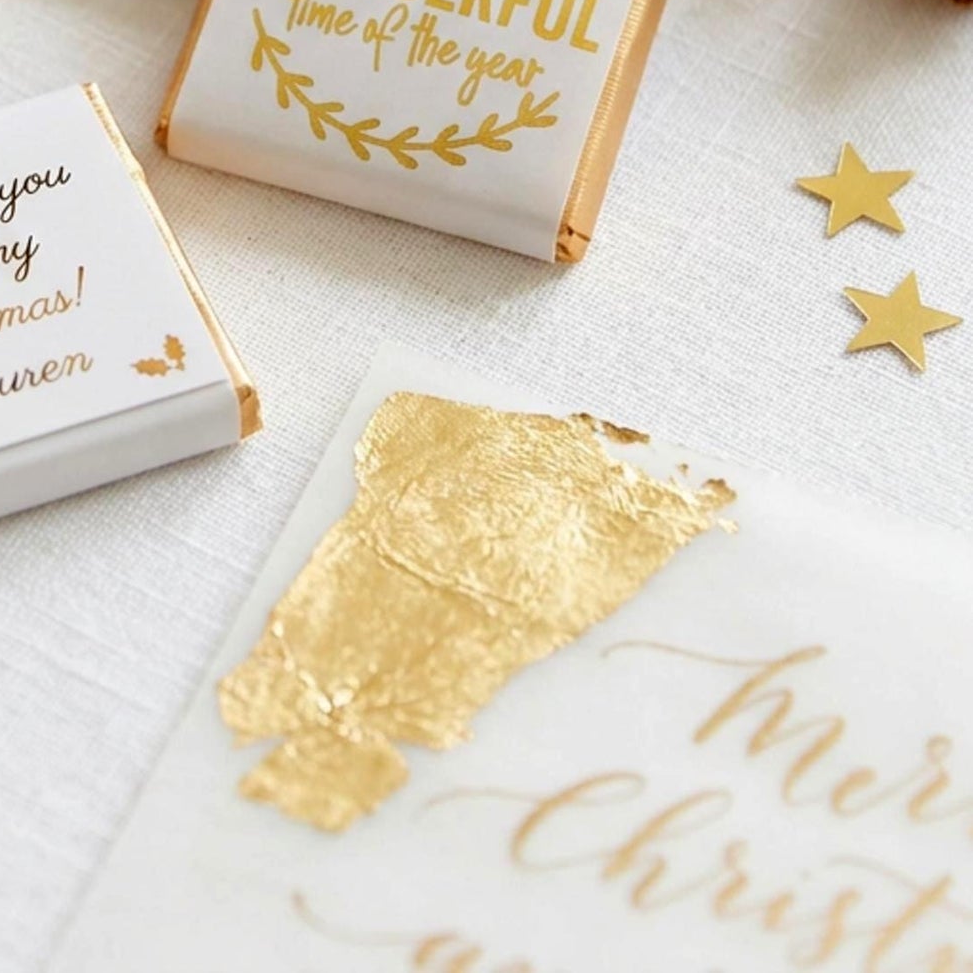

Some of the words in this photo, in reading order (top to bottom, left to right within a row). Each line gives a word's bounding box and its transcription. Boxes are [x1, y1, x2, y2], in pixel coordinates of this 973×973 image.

[362, 3, 409, 72] of
[407, 13, 461, 68] the
[457, 43, 545, 107] year
[600, 639, 973, 825] Mer
